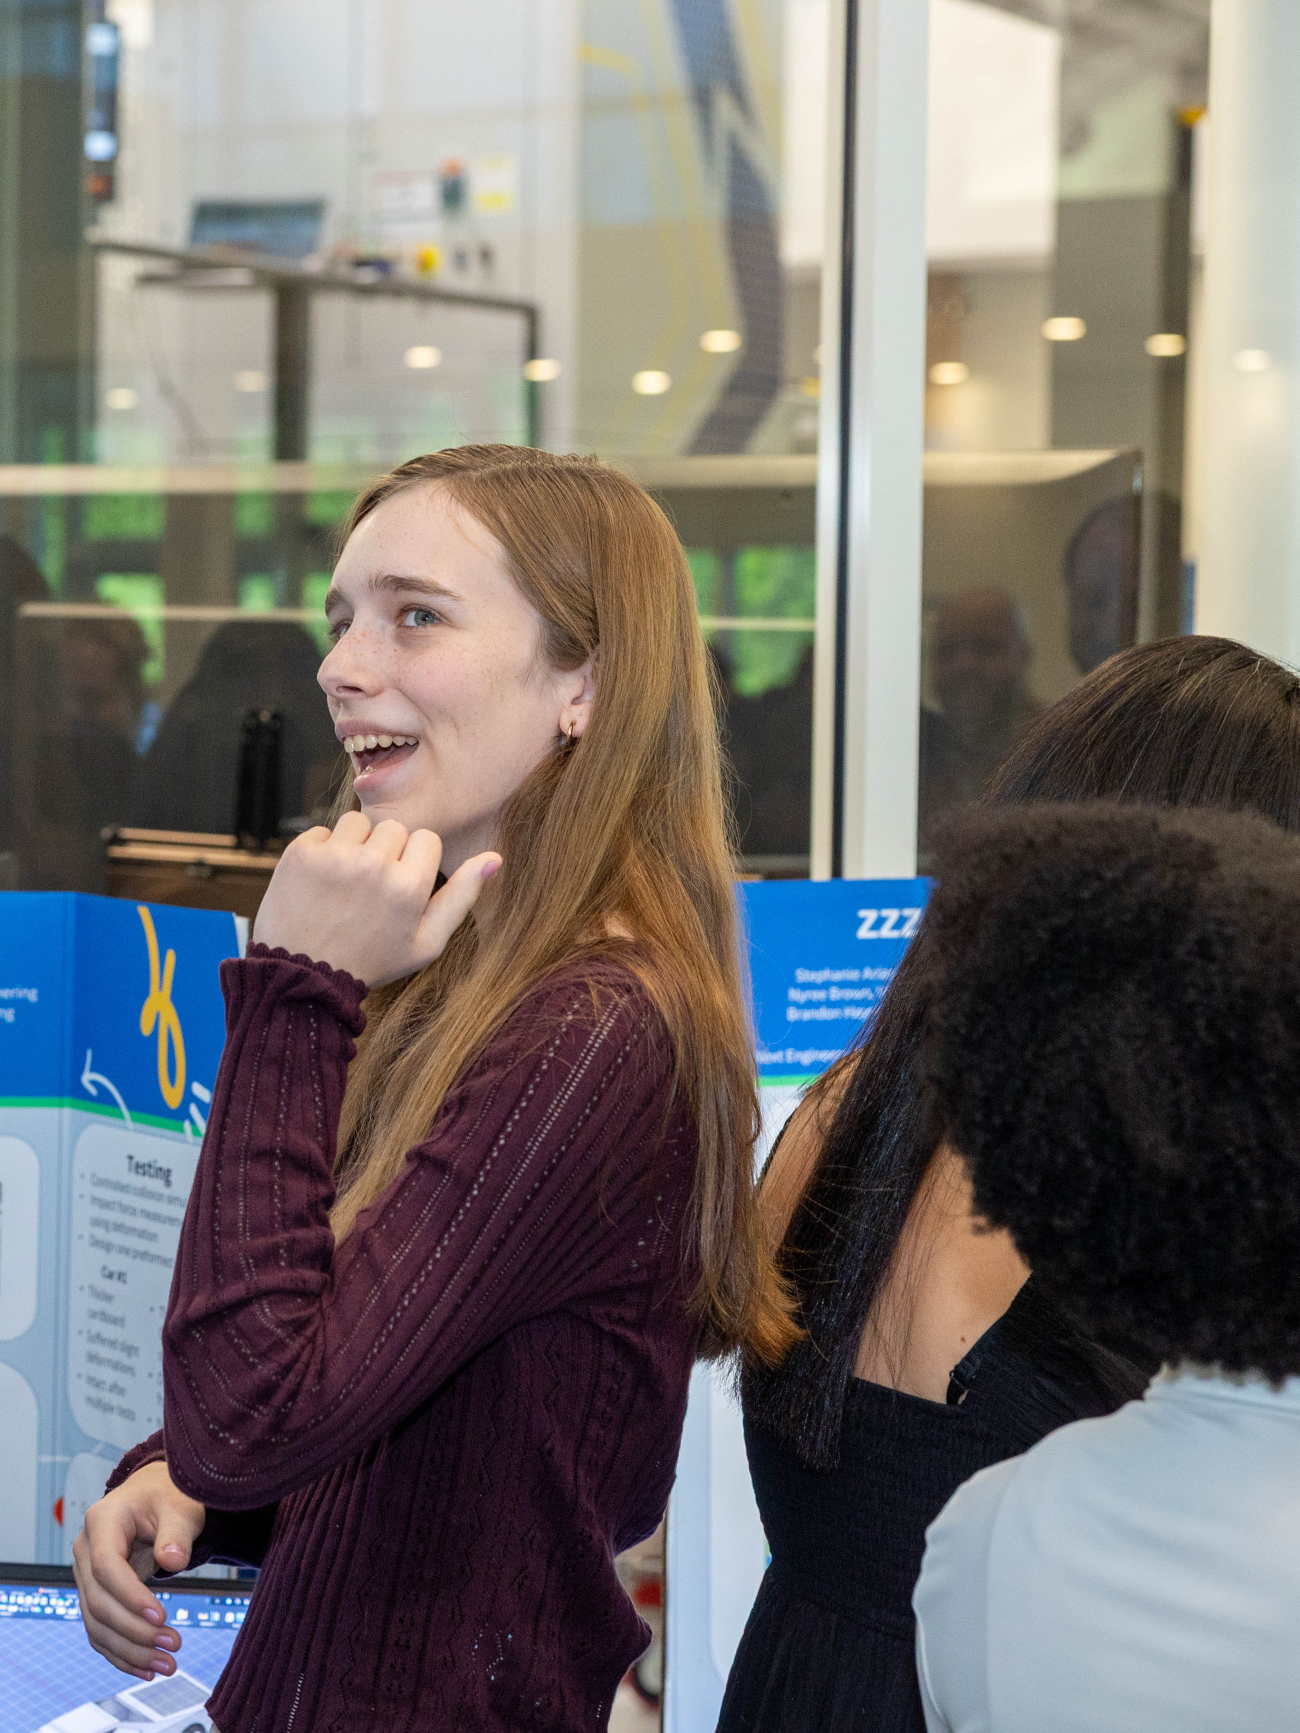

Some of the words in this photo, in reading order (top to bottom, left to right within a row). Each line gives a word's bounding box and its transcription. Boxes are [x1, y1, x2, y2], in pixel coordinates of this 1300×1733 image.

[795, 968, 860, 984] Stephanie
[127, 1154, 173, 1188] Testing
[100, 1265, 115, 1280] Car
